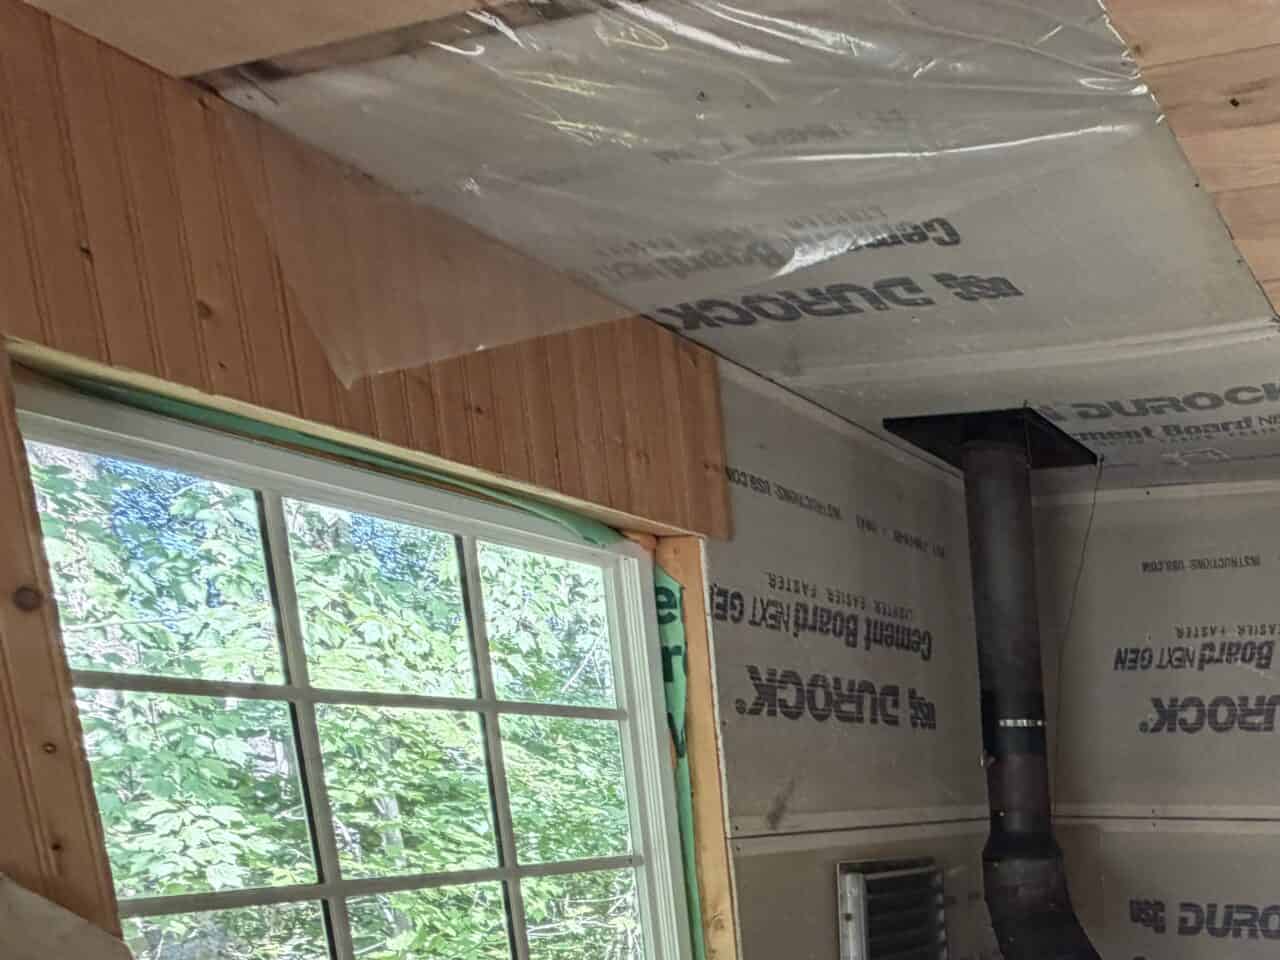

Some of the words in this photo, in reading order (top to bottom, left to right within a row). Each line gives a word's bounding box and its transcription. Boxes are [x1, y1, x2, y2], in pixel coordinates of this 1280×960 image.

[656, 276, 936, 333] DUROCK
[1072, 422, 1156, 444] ment
[1161, 415, 1255, 438] Board
[747, 594, 791, 634] NEXT
[792, 604, 859, 649] Board
[863, 616, 933, 662] Cement
[1154, 645, 1196, 670] NEXT
[1197, 638, 1275, 672] Board
[1113, 646, 1154, 672] GEN
